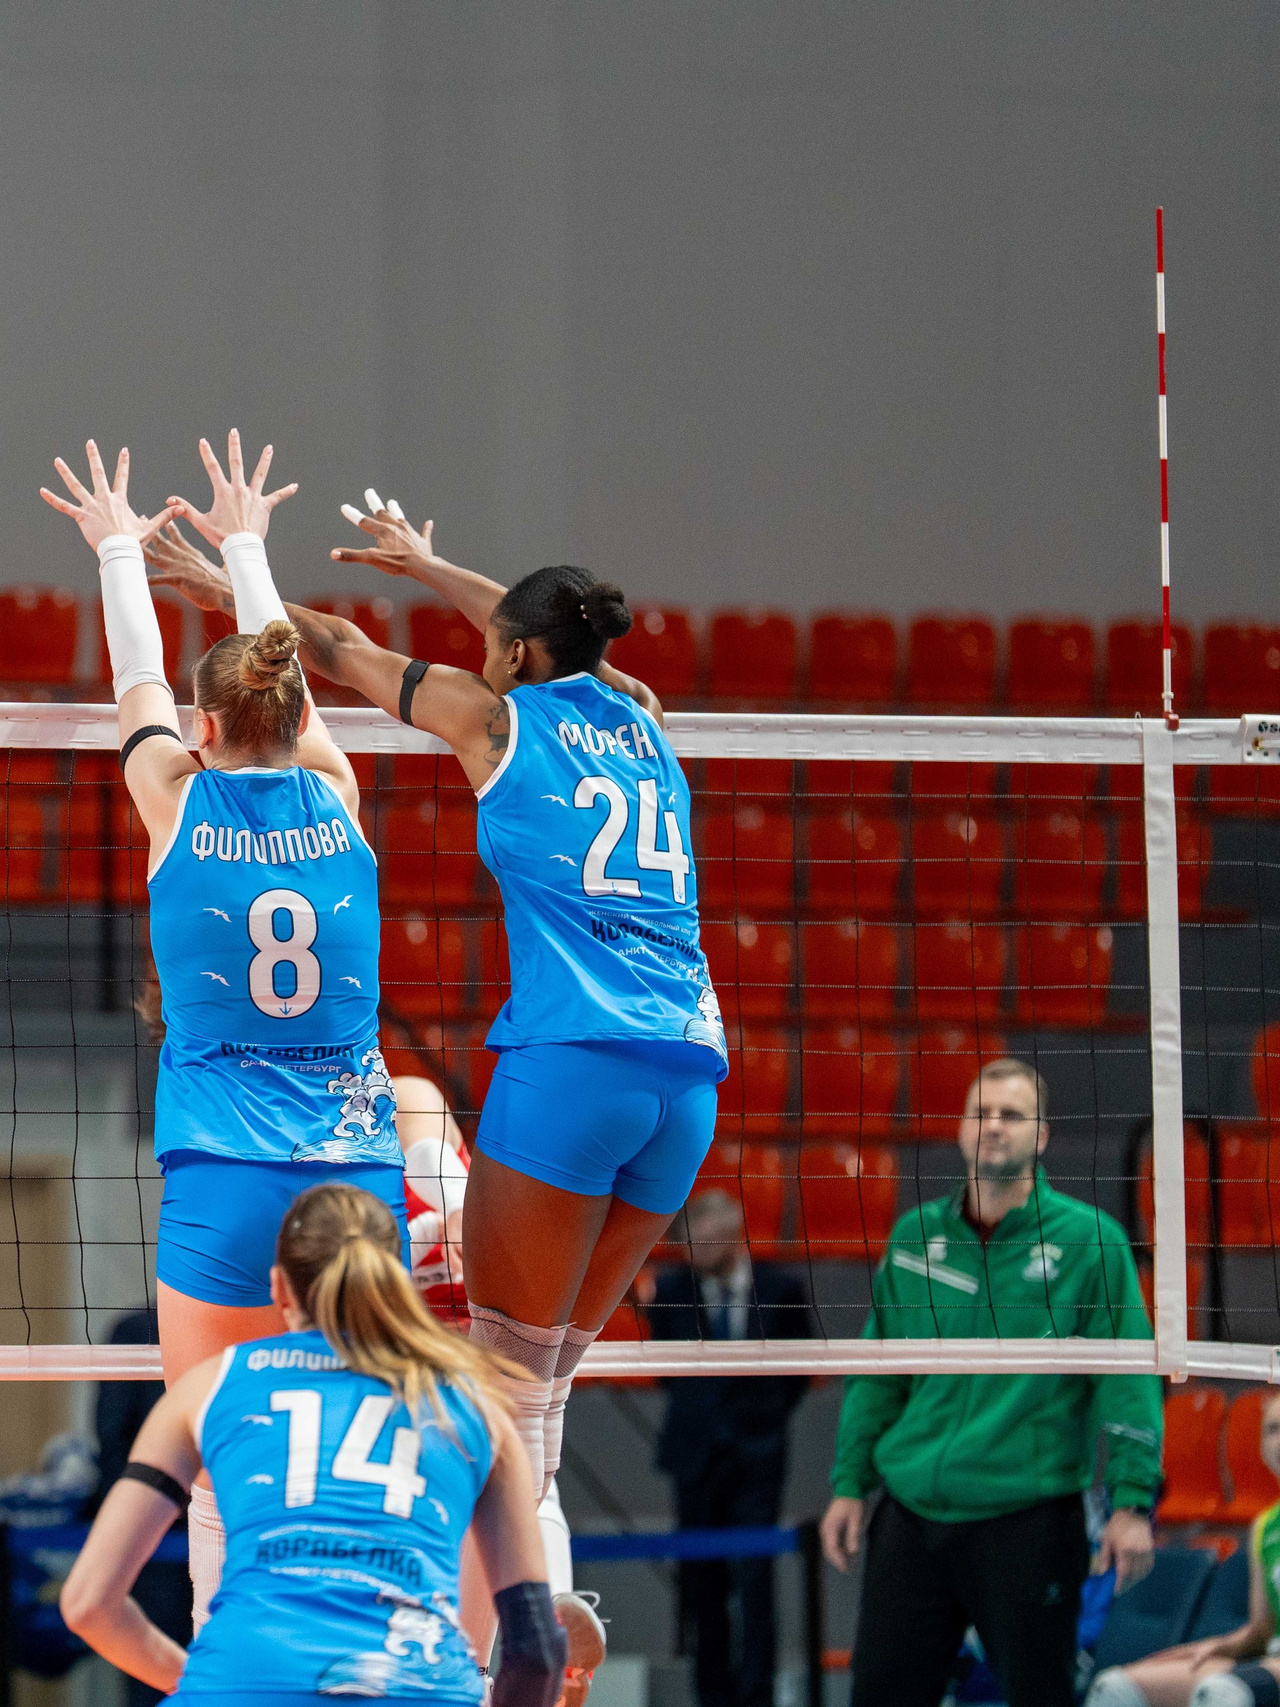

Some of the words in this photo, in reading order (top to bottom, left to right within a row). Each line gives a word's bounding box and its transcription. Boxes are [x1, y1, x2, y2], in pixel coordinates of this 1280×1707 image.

[191, 817, 352, 865] ФИЛИППОВА
[573, 775, 690, 905] 24
[247, 888, 322, 1019] 8
[270, 1389, 427, 1520] 14
